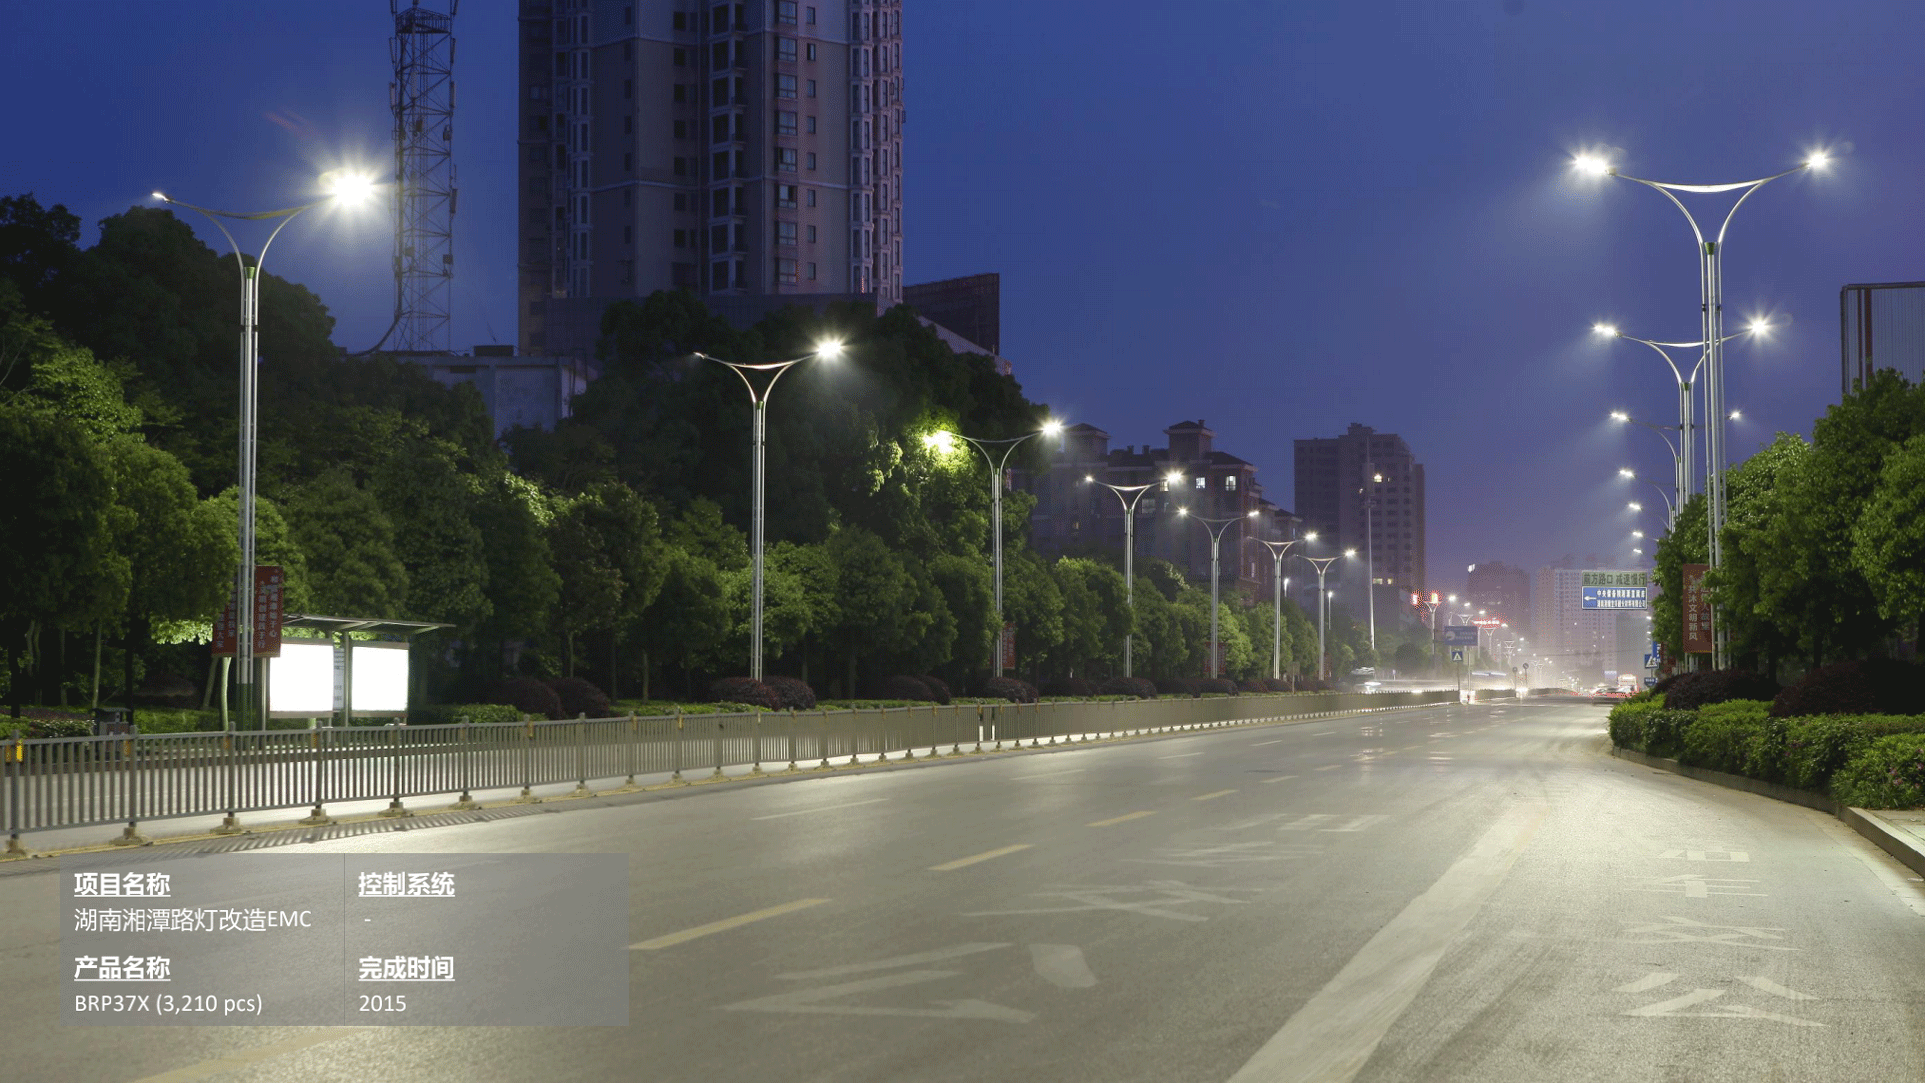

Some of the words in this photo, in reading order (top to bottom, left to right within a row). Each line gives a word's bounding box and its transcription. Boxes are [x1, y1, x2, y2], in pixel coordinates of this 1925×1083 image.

[1584, 573, 1613, 585] 前方路口
[1616, 573, 1645, 585] 减速慢行
[1688, 584, 1698, 641] 共沐文明新风
